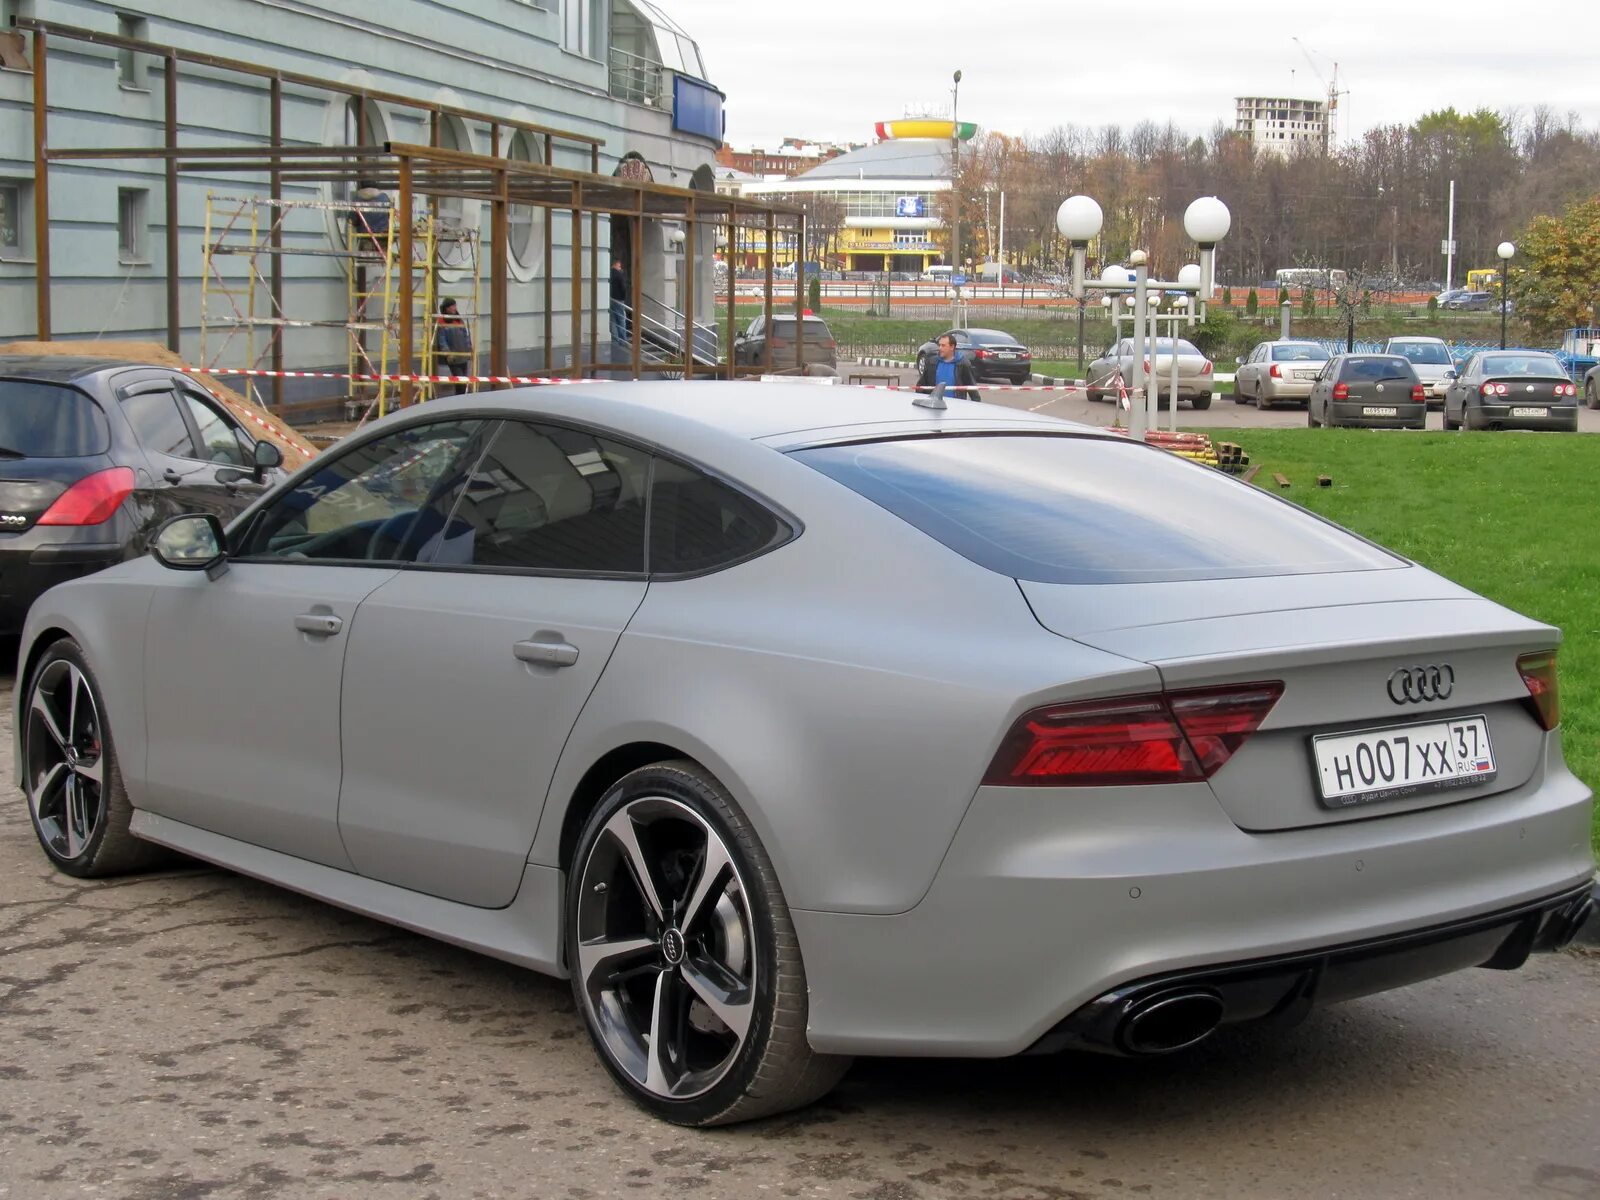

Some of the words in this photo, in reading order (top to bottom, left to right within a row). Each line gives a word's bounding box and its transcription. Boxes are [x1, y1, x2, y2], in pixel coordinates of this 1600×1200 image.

[1454, 725, 1478, 759] 37
[1458, 760, 1476, 772] RUS
[1361, 792, 1379, 802] Ауди
